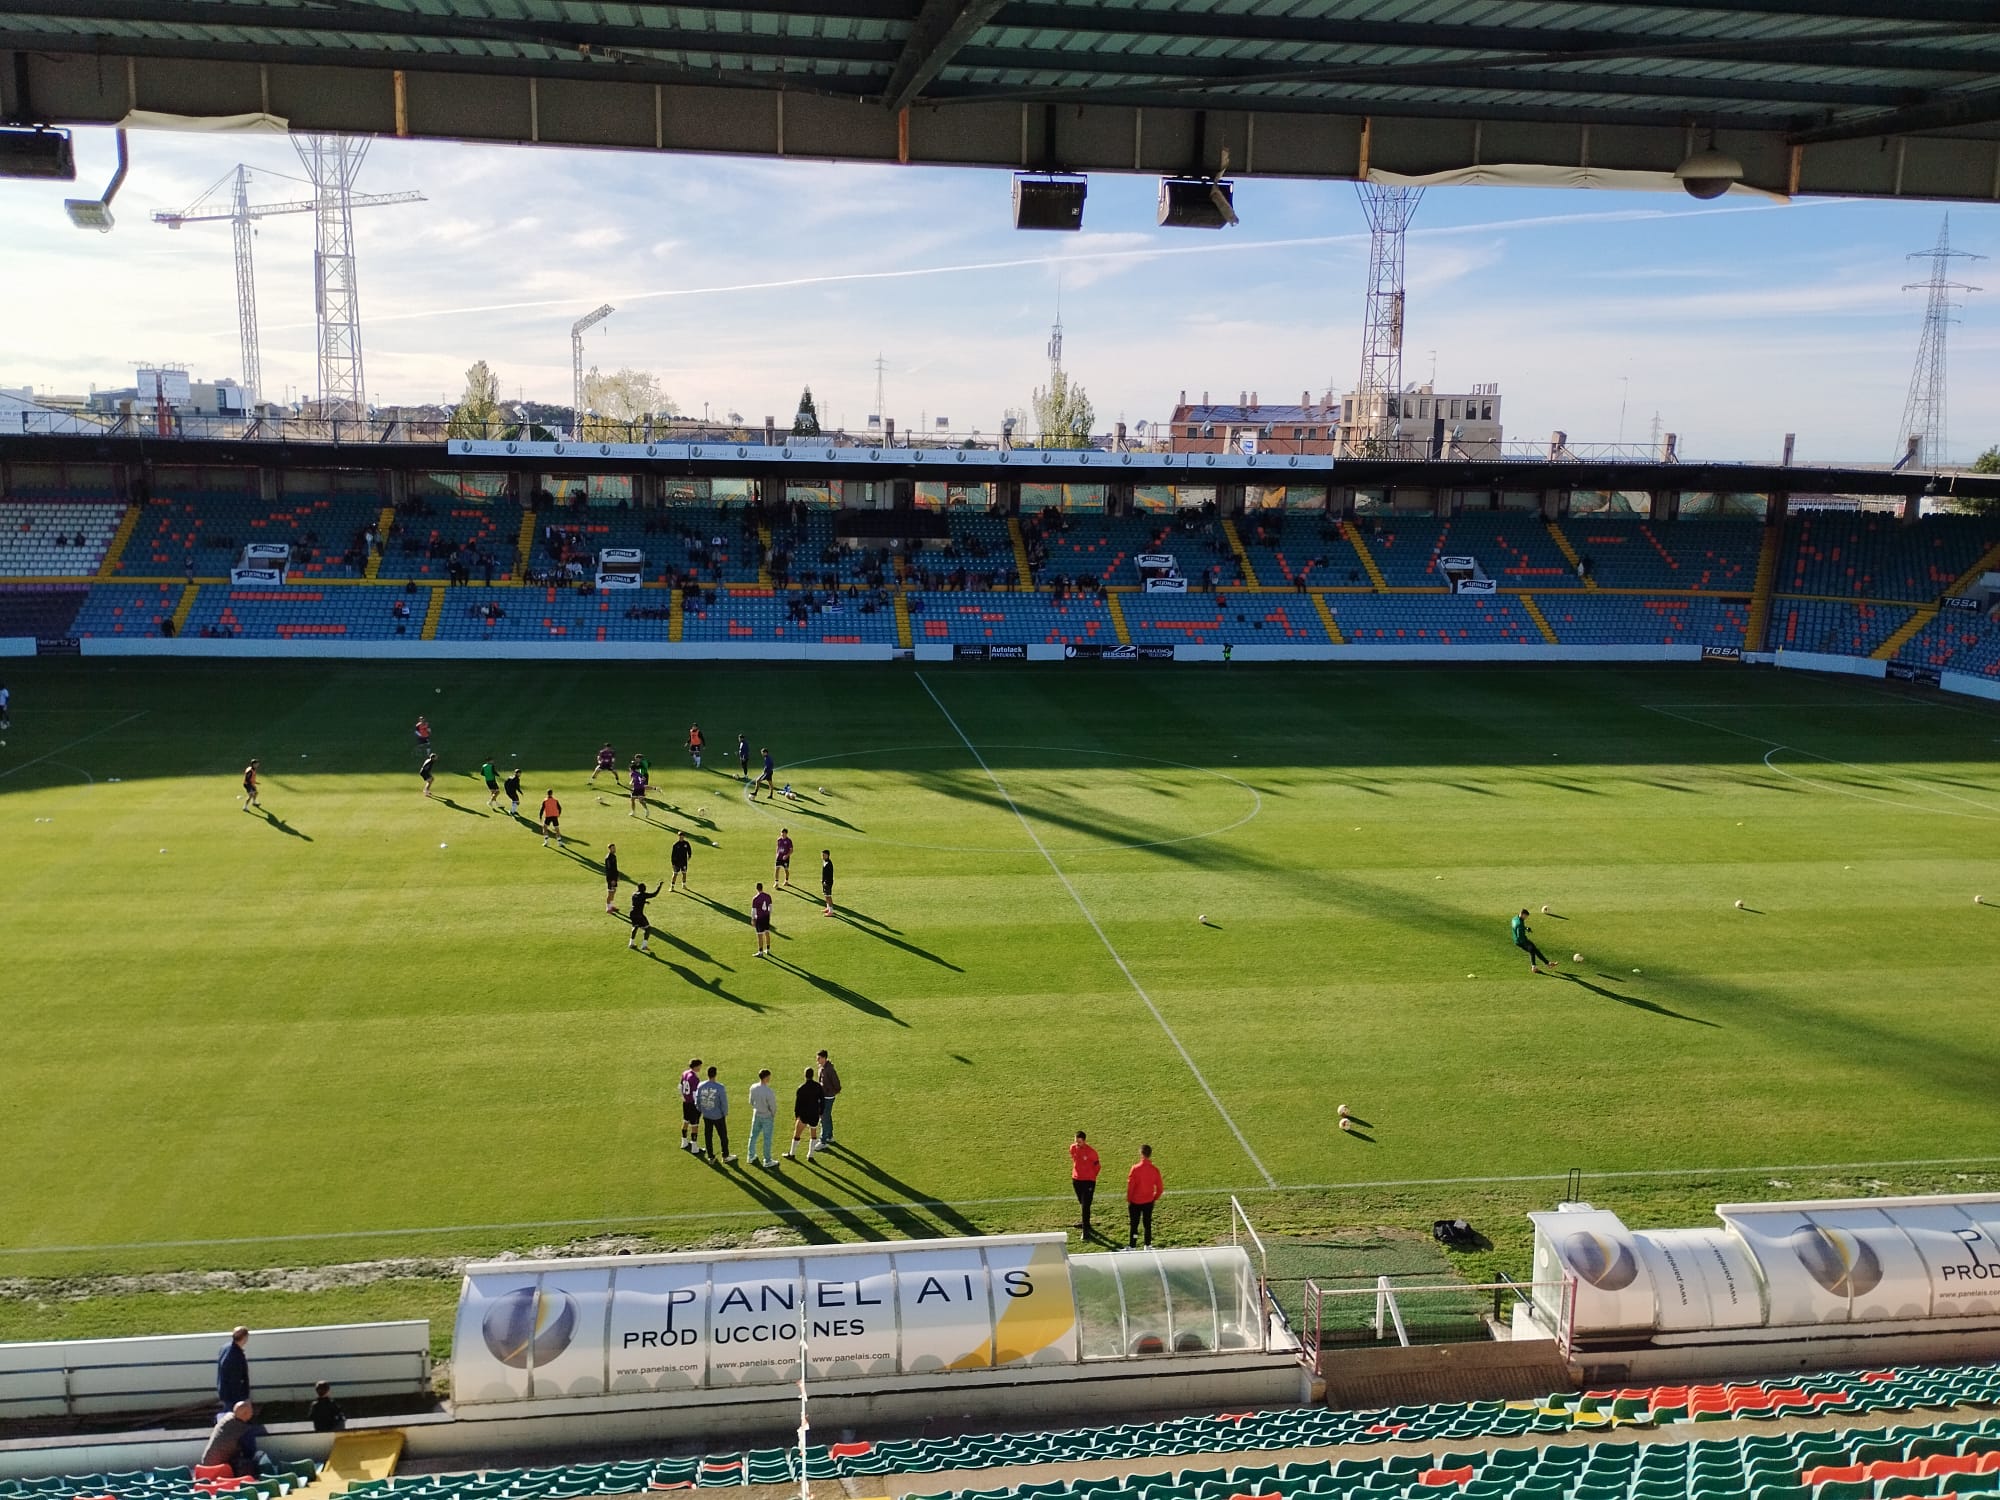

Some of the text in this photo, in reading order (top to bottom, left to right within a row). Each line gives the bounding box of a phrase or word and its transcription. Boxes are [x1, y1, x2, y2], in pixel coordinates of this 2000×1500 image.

[1944, 597, 1977, 609] TGSA
[1704, 646, 1739, 656] TGSA
[762, 900, 767, 911] 4
[623, 1319, 865, 1349] PRODUCCIONES
[716, 1357, 796, 1370] www.panelais.com
[812, 1351, 890, 1364] www.panelais.com
[616, 1363, 698, 1376] www.panelais.com
